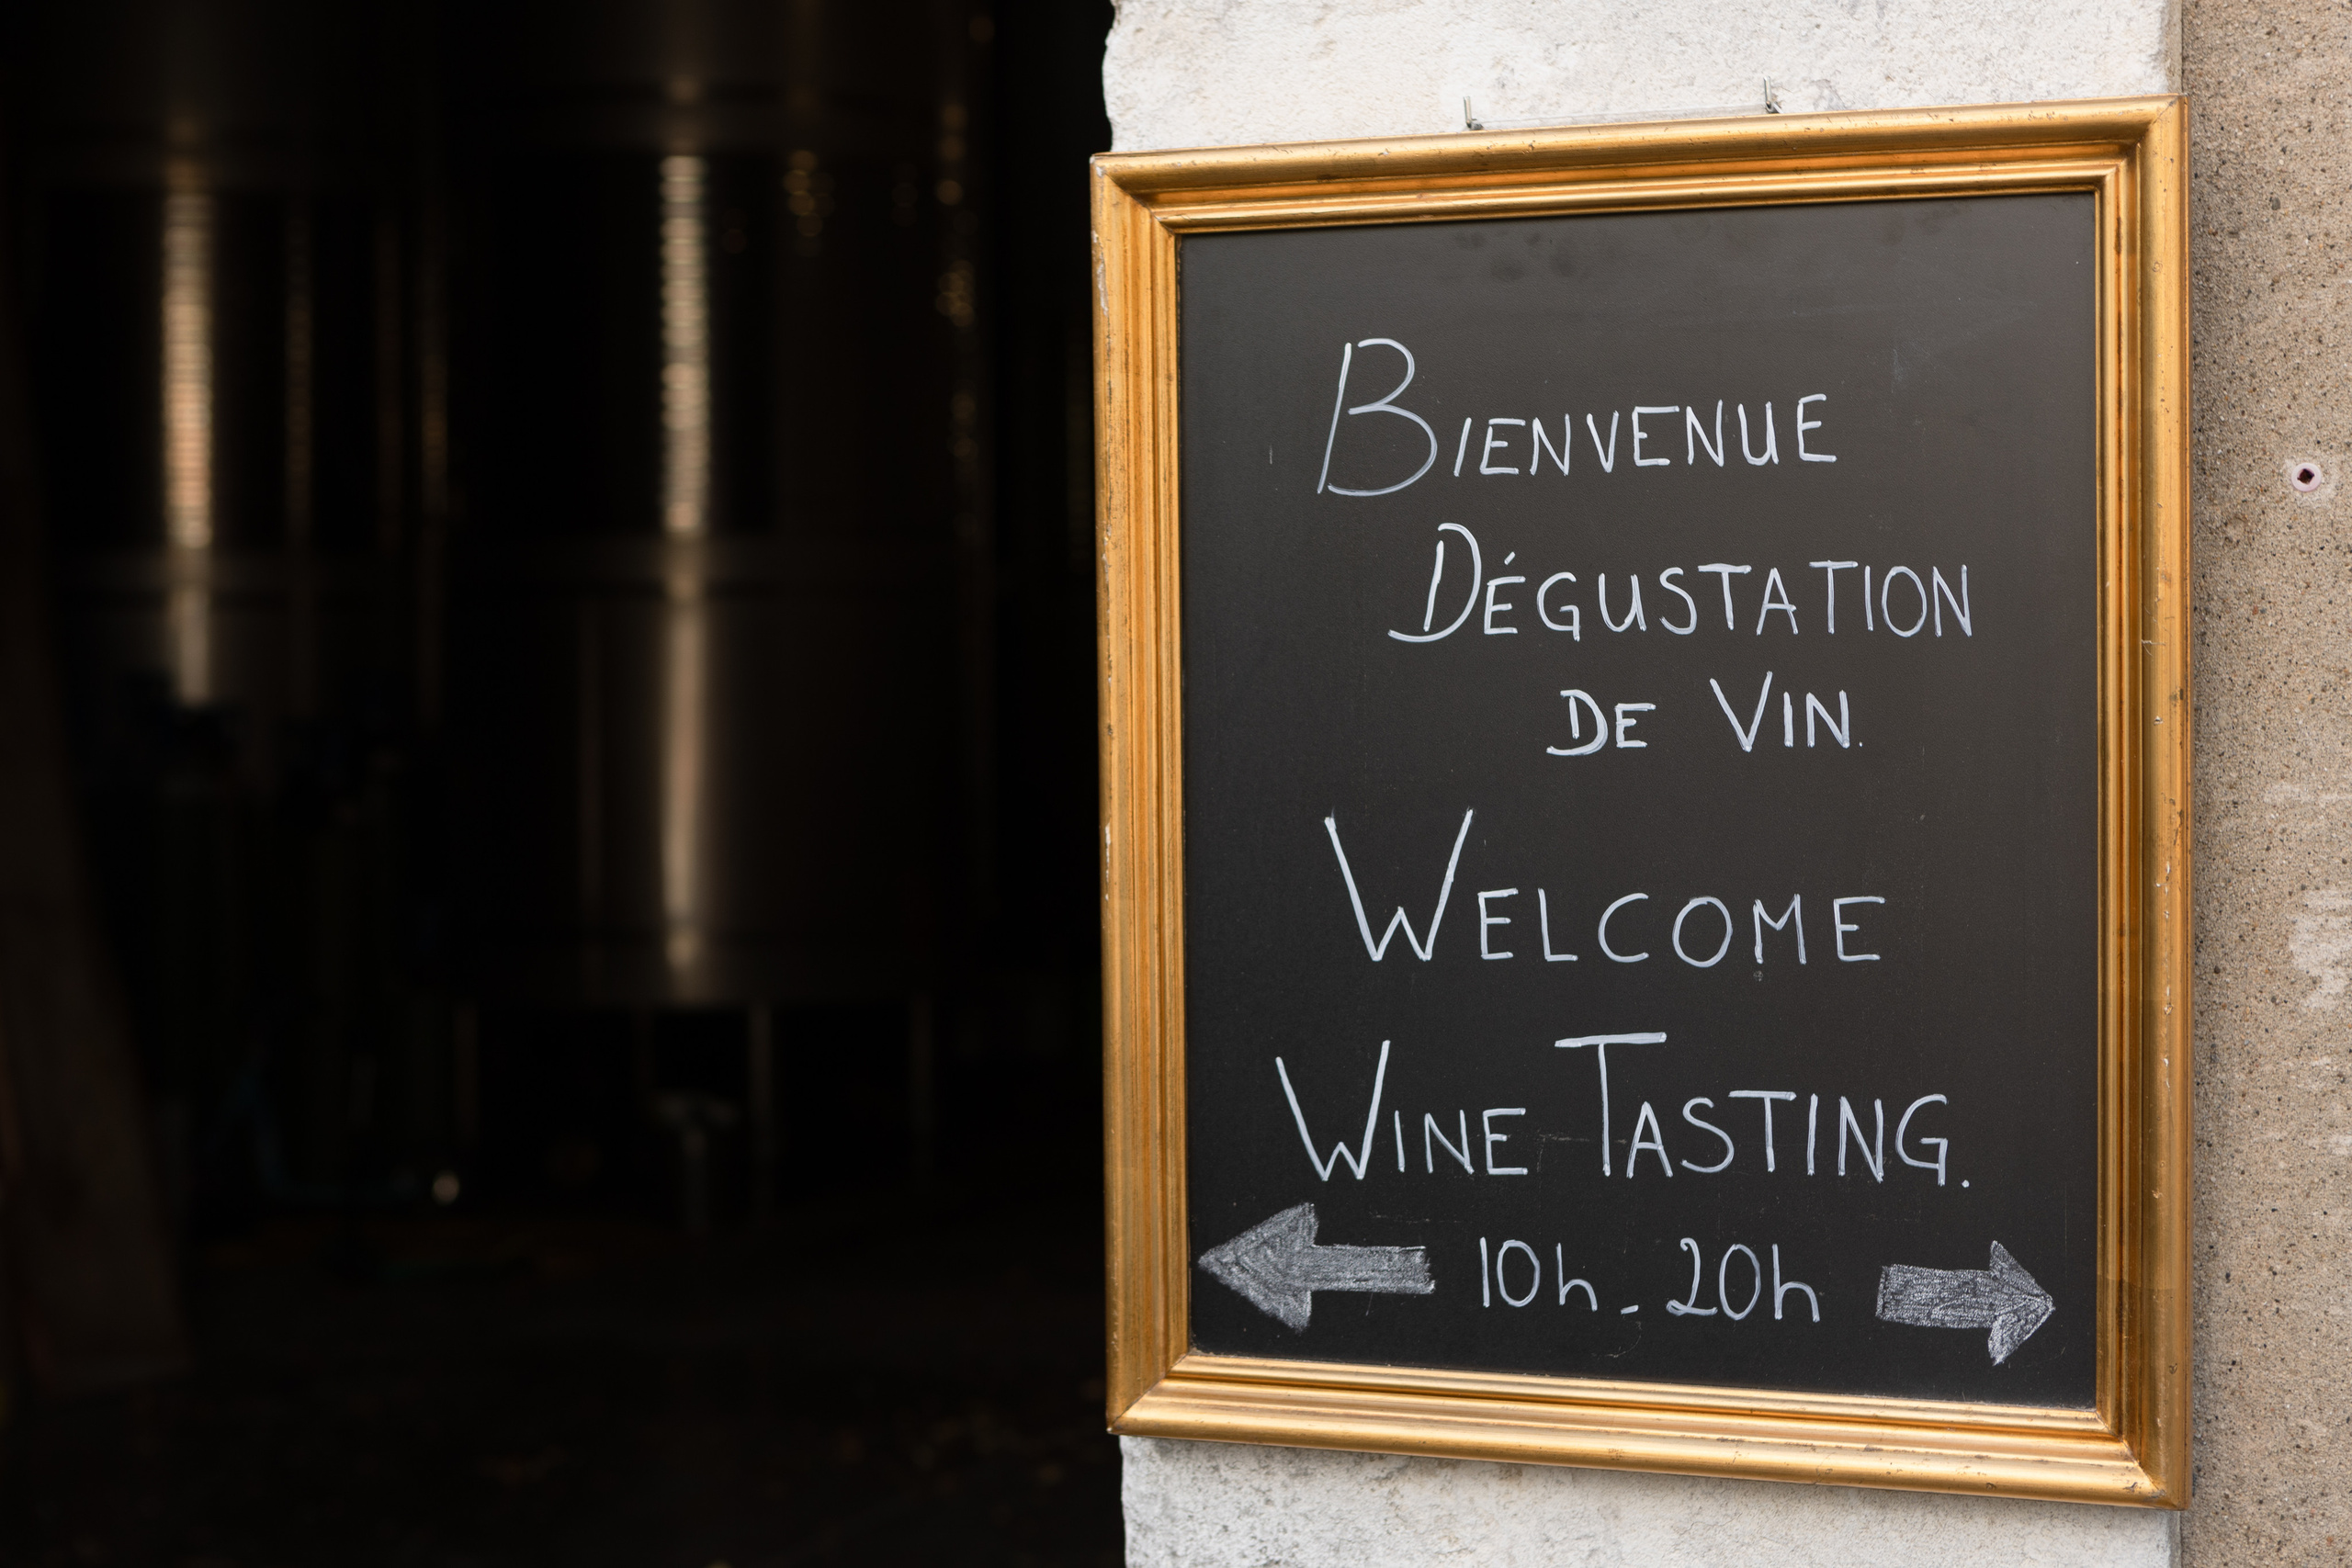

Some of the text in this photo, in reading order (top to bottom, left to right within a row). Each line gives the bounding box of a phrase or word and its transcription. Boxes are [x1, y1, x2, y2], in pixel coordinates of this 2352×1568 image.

[1316, 336, 1838, 498] BIENVENUE
[1386, 521, 1973, 644] DÉGUSTATION
[1544, 687, 1657, 757] DE
[1323, 807, 1886, 969] WELCOME
[1274, 1031, 1971, 1190] WINE TASTING.
[1478, 1235, 1599, 1313] 10h
[1665, 1236, 1821, 1324] 20h
